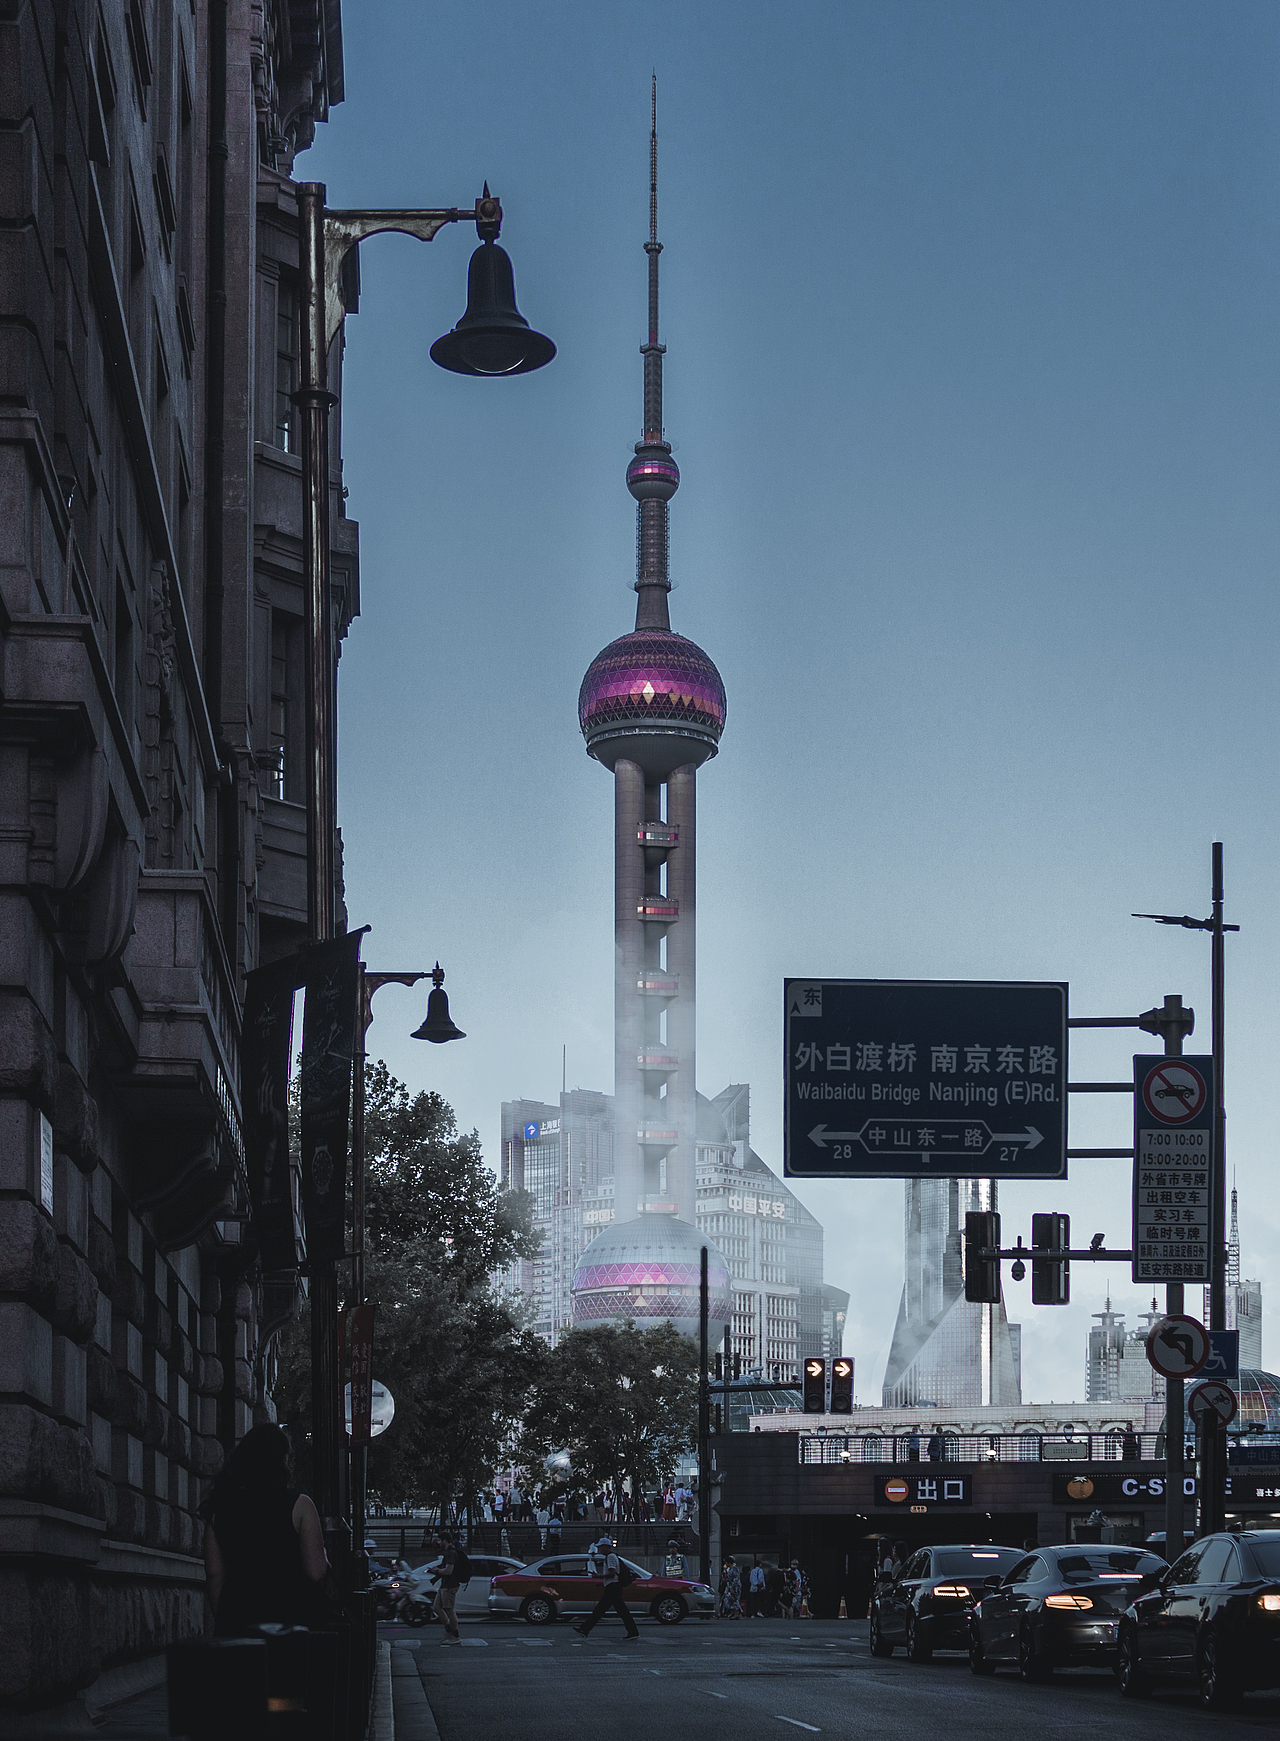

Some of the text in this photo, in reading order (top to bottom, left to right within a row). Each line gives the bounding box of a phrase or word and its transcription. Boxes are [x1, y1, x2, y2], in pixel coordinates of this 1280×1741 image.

[803, 987, 821, 1006] 东
[794, 1042, 1058, 1075] 外白渡桥 南京东路
[797, 1082, 865, 1100] Waibaidu
[871, 1083, 921, 1106] Bridge
[929, 1082, 998, 1107] Nanjing
[868, 1127, 984, 1148] 中山东一路
[1147, 1133, 1203, 1146] 7:00 10:00
[833, 1145, 852, 1159] 28
[999, 1148, 1019, 1162] 27
[1142, 1173, 1206, 1186] 外省市号牌
[1147, 1190, 1201, 1204] 出租空车
[728, 1194, 786, 1219] 中国平安
[1154, 1209, 1195, 1222] 实习车
[1146, 1226, 1200, 1240] 临时号牌
[1141, 1262, 1204, 1276] 延安东路隧道
[917, 1478, 964, 1501] 出口
